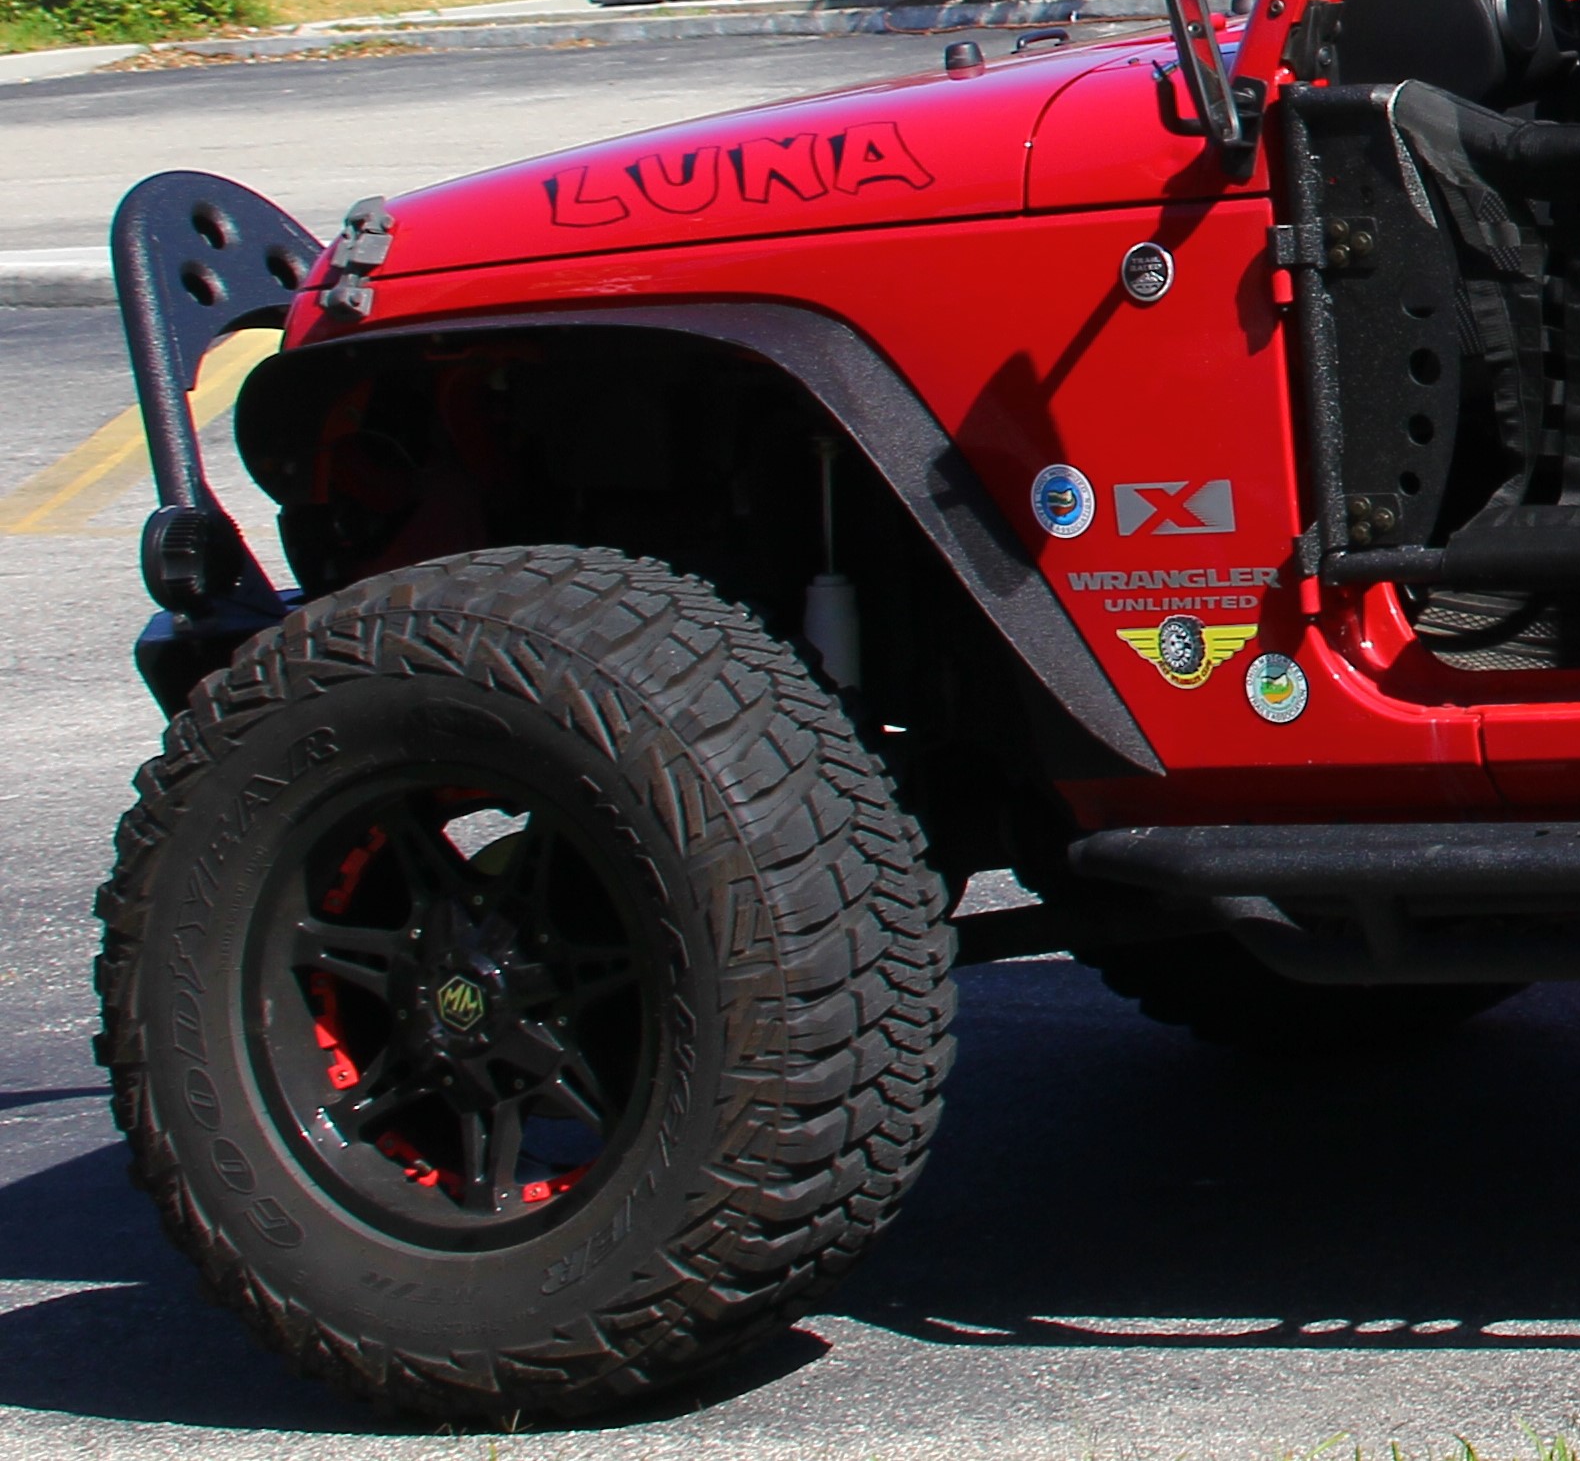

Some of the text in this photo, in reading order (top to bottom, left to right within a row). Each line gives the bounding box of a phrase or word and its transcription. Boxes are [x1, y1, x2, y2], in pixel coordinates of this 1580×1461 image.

[541, 121, 935, 229] LUNA
[1067, 567, 1282, 591] WRANGLER
[1104, 595, 1259, 612] UNLIMITED
[170, 725, 341, 1248] GOODYEAR
